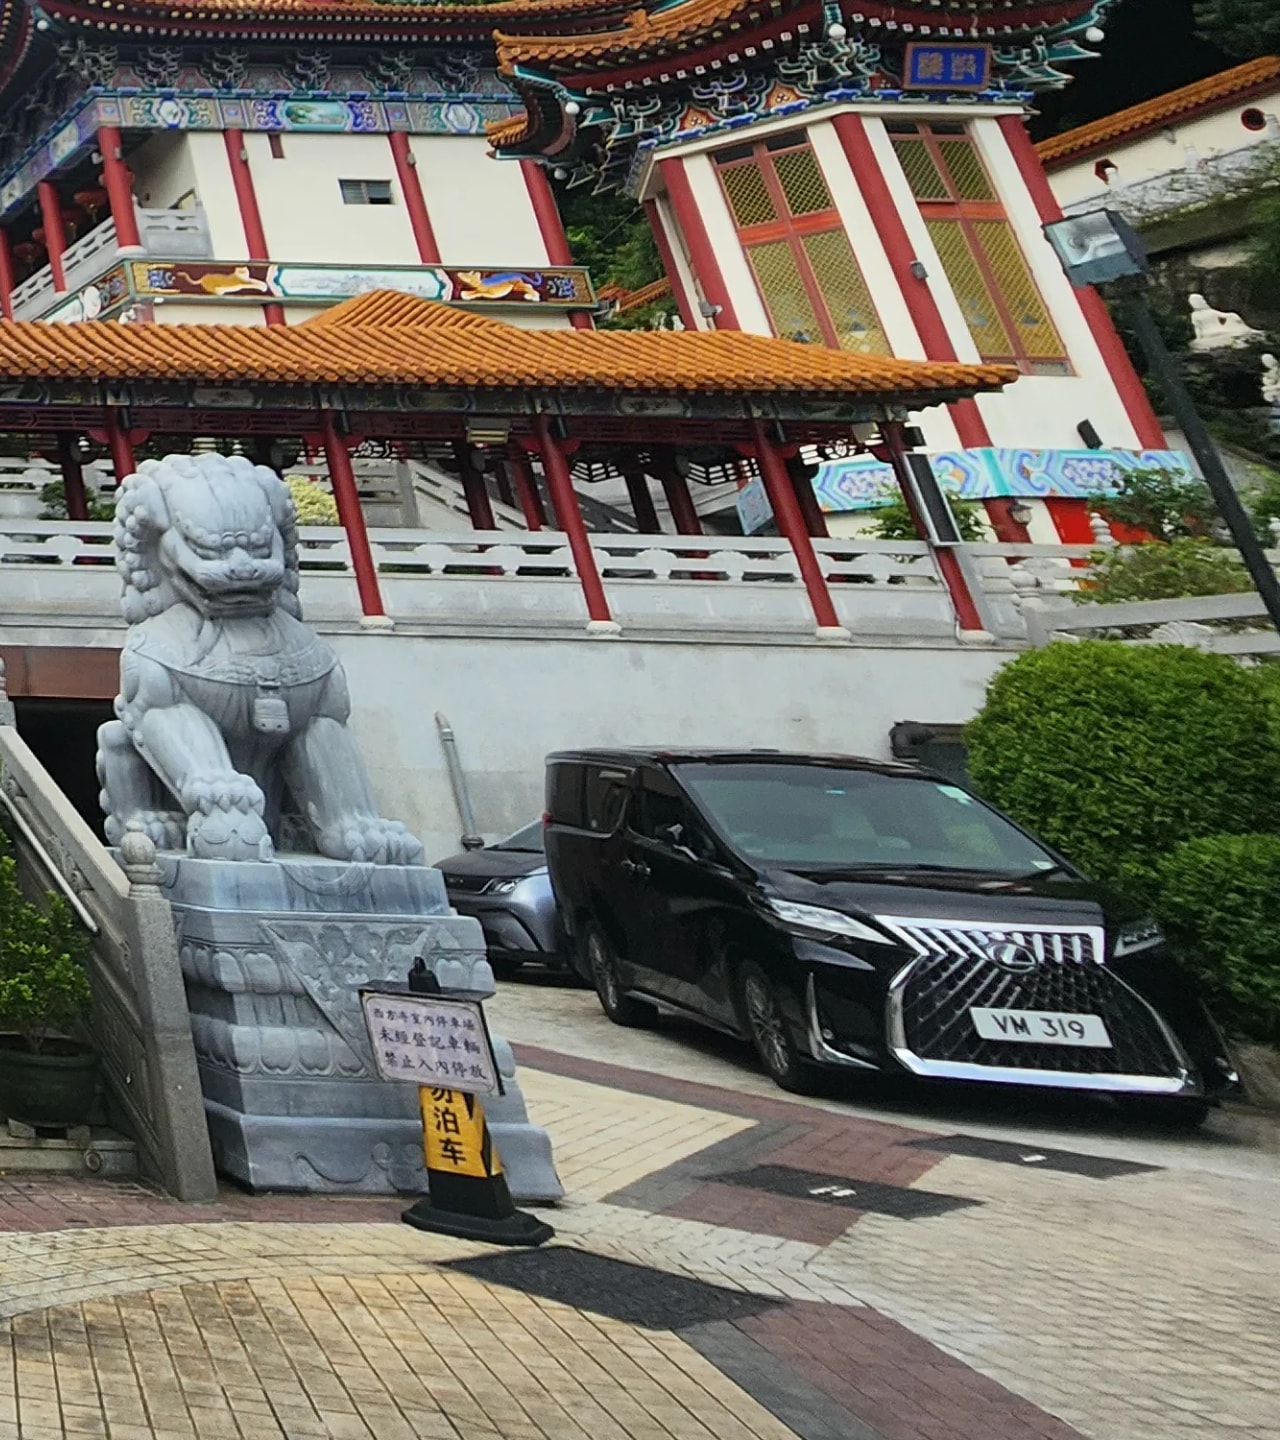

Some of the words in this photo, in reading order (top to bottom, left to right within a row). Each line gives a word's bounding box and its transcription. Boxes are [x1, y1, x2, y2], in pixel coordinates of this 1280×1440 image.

[991, 1013, 1032, 1036] VM
[1040, 1017, 1085, 1039] 319
[379, 1027, 481, 1055] 未經登記車輛
